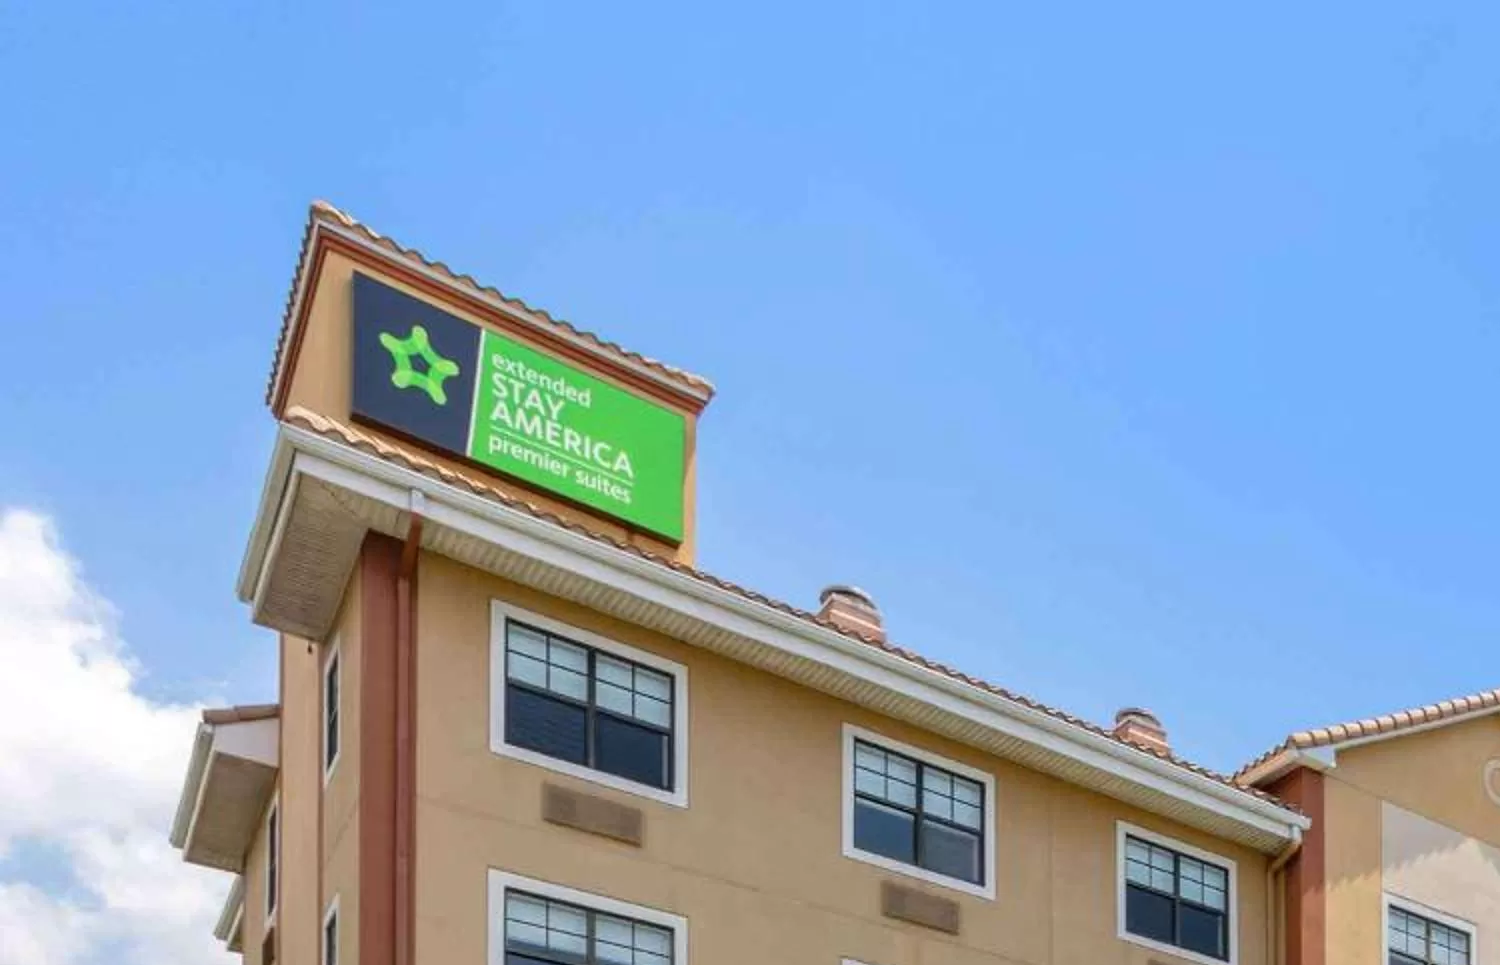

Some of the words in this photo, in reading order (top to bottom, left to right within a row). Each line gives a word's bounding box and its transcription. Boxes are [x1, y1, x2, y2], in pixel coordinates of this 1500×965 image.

[491, 353, 592, 409] extended
[492, 372, 566, 421] STAY
[488, 434, 571, 478] premier
[575, 469, 633, 505] suites
[490, 401, 634, 479] AMERICA
